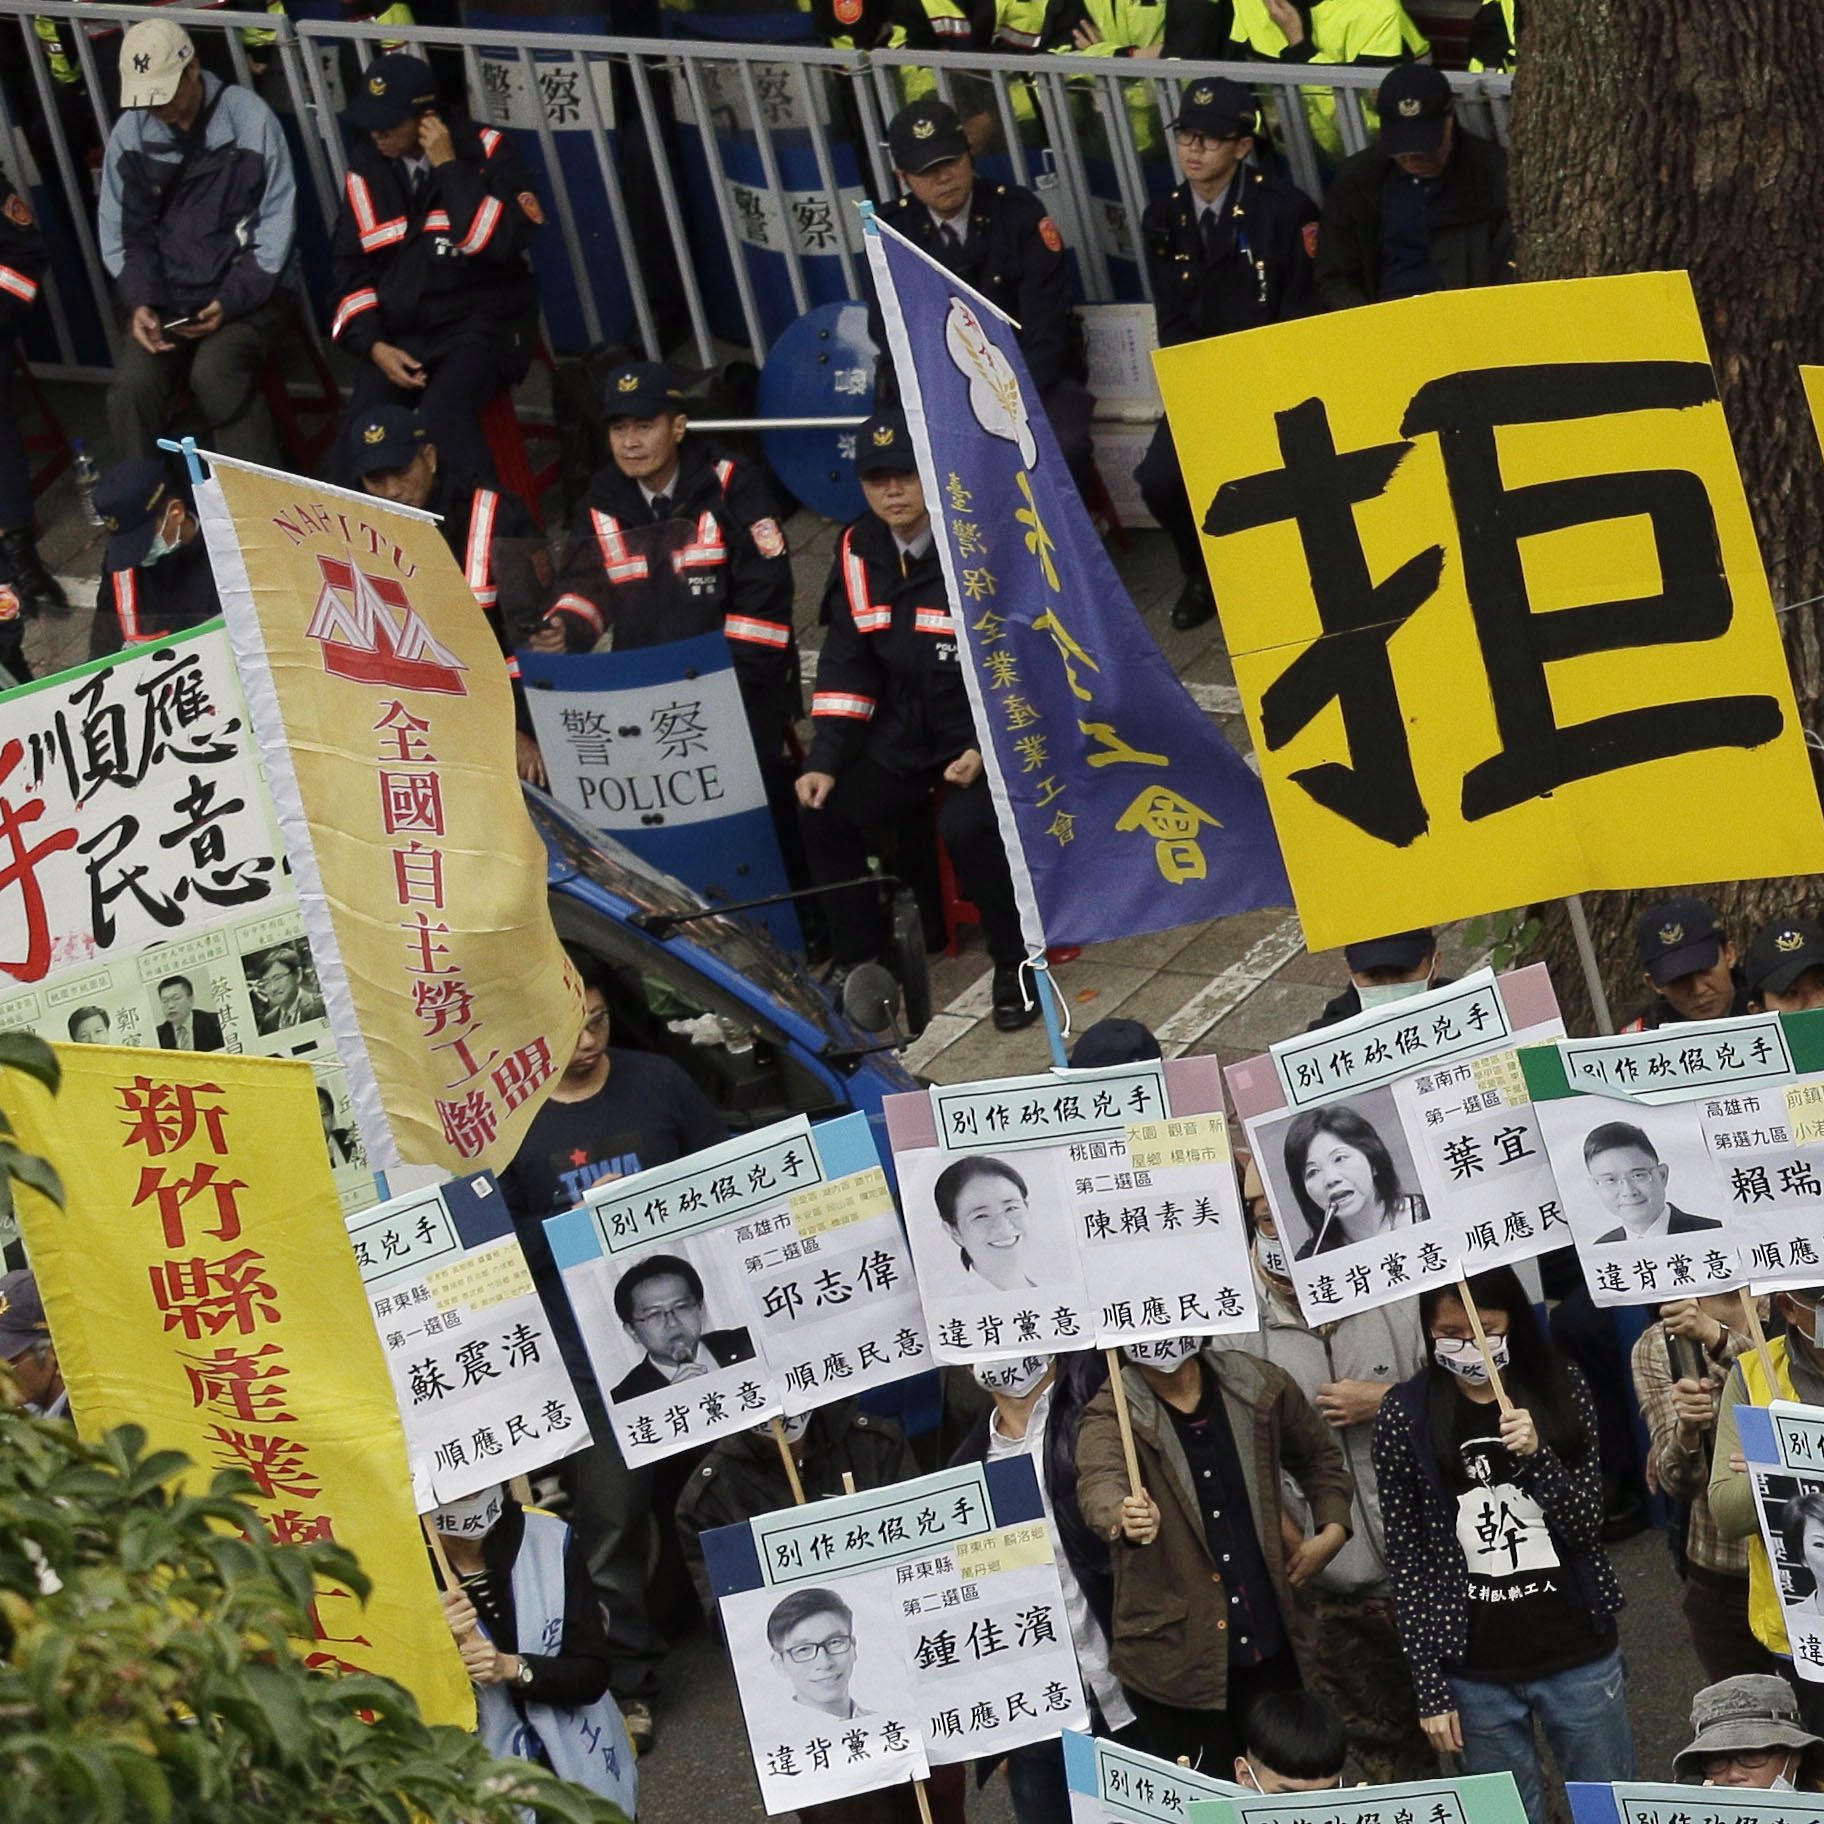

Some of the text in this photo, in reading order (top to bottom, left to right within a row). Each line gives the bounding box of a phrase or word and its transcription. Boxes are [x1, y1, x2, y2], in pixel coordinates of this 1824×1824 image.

[1206, 359, 1783, 848] 拒
[577, 765, 725, 811] POLICE
[950, 1089, 1153, 1136] 別作砍假兇手
[1424, 1087, 1501, 1129] 第一選區
[1706, 1097, 1760, 1118] 高雄市
[1069, 1142, 1127, 1160] 桃園市
[1084, 1199, 1221, 1239] 陳賴素美
[744, 1238, 821, 1273] 第二選區
[374, 1284, 430, 1319] 屏東縣
[763, 1250, 897, 1321] 邱志偉
[409, 1324, 543, 1403] 蘇震清
[435, 1400, 573, 1472] 順應民意
[1475, 1501, 1538, 1569] 幹
[895, 1555, 955, 1583] 屏東縣
[930, 1681, 1073, 1738] 順應民意
